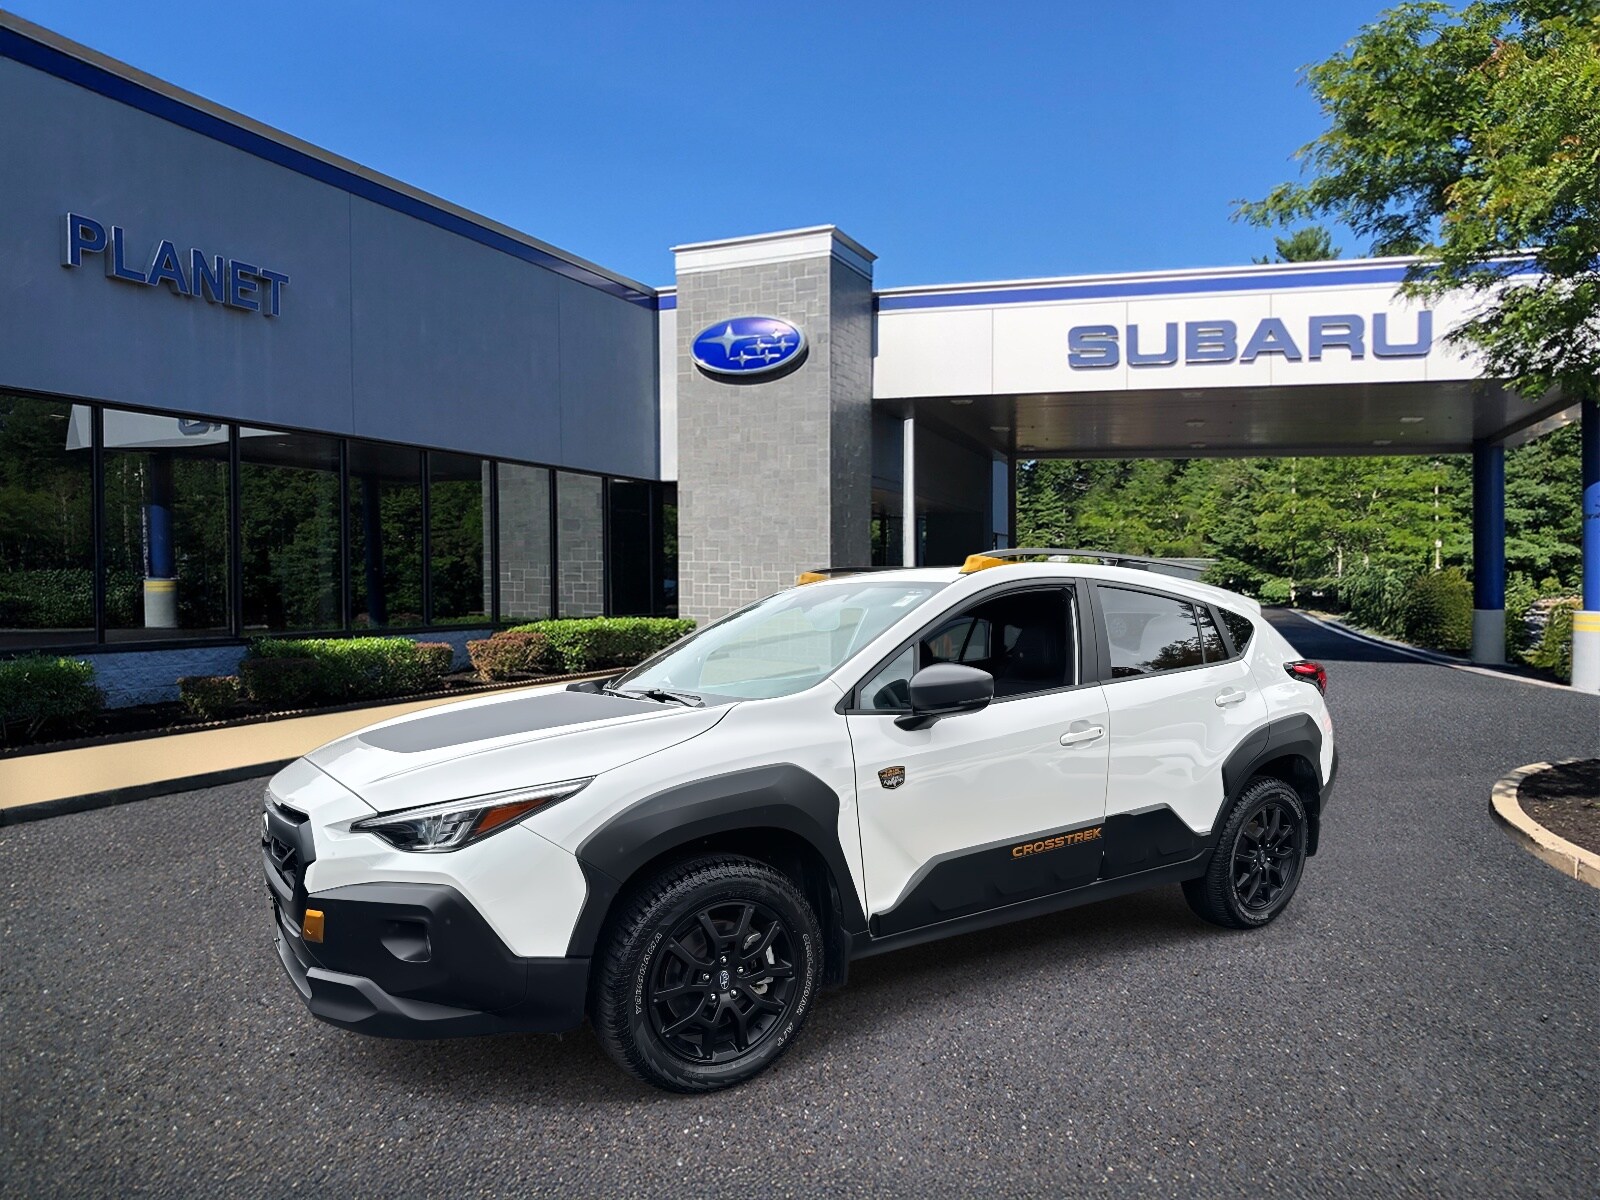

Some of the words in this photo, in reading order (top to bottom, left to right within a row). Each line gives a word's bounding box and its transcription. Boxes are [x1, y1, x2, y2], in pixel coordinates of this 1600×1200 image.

[62, 212, 289, 317] PLANET
[1067, 310, 1433, 369] SUBARU
[1011, 827, 1103, 859] CROSSTREK
[634, 932, 663, 1015] YOKOHAMA
